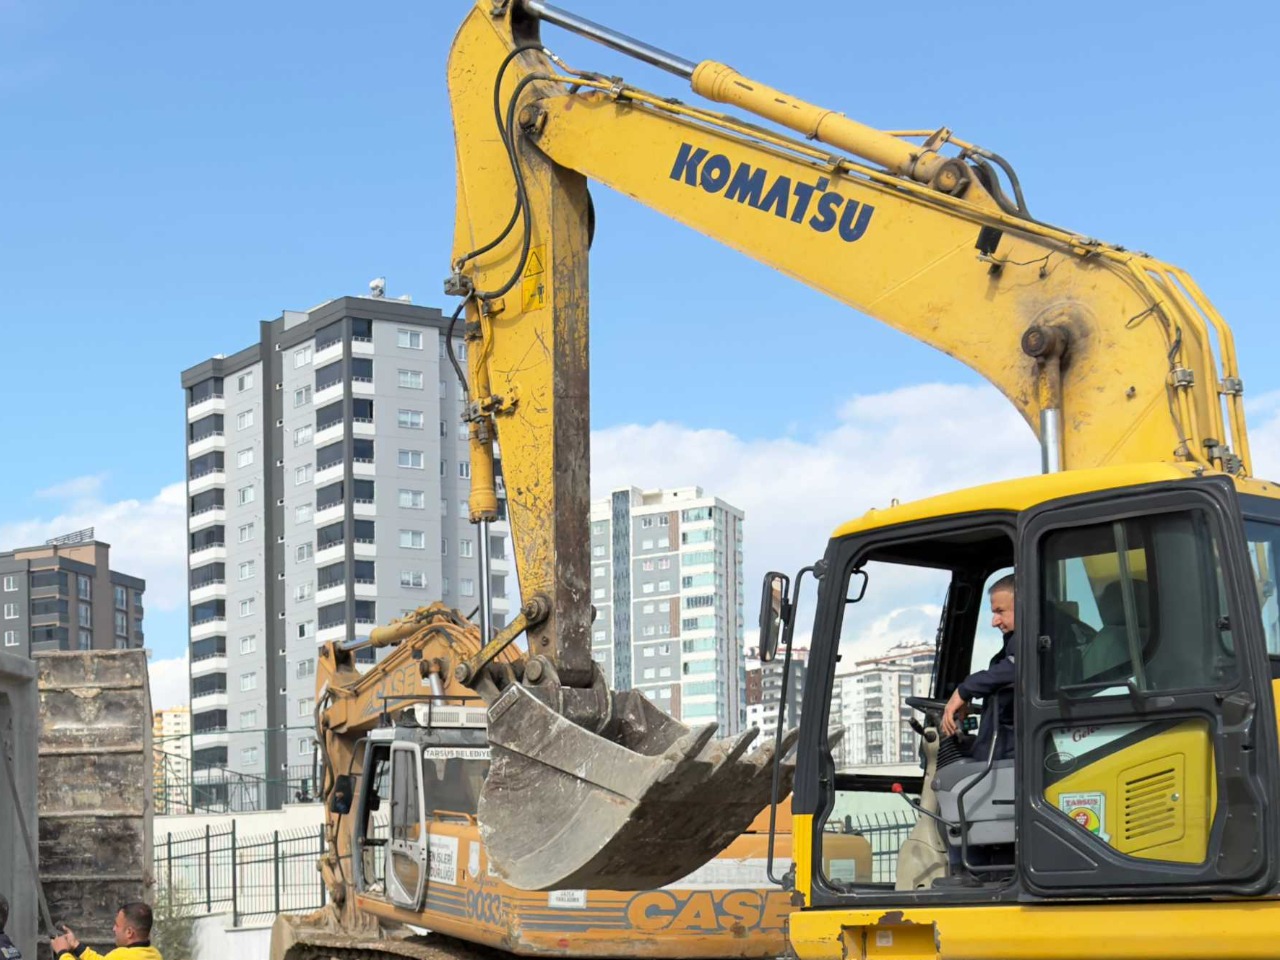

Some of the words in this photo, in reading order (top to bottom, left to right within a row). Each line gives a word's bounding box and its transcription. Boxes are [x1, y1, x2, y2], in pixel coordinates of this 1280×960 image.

[670, 141, 875, 243] KOMATSU
[426, 750, 454, 758] TARSUS
[626, 889, 796, 932] CASE
